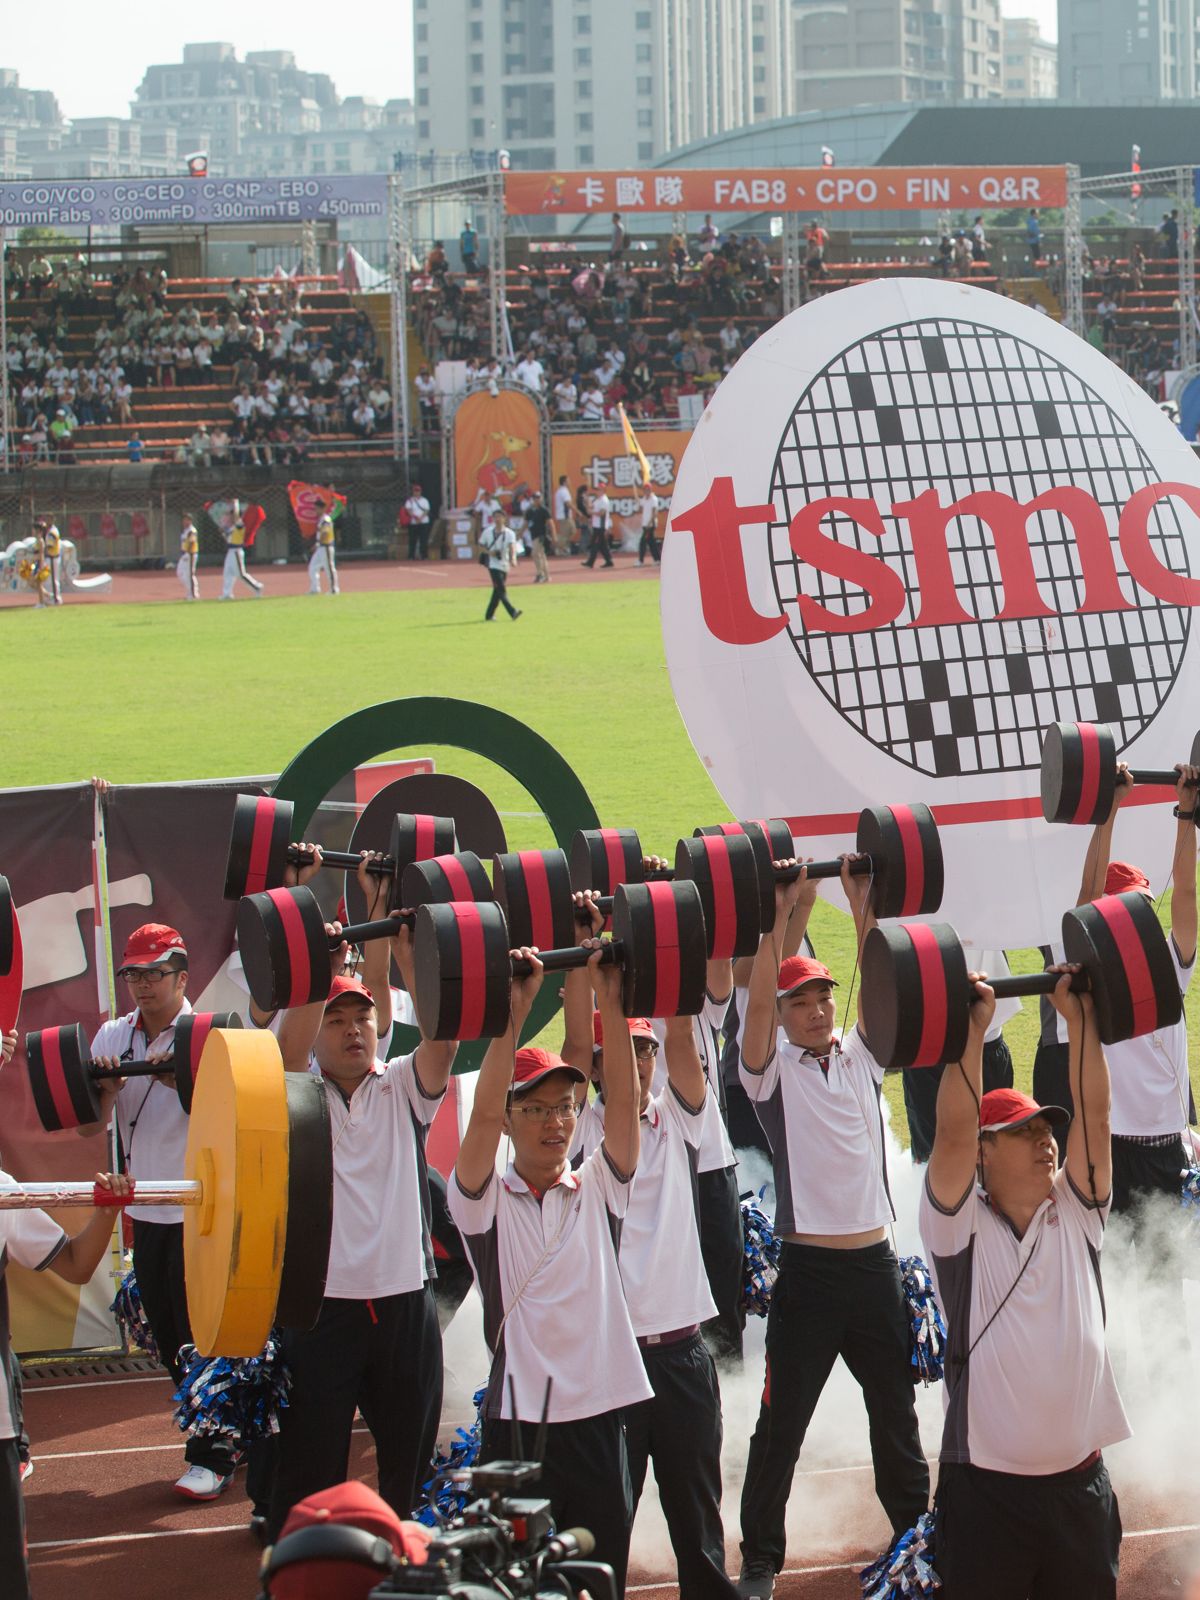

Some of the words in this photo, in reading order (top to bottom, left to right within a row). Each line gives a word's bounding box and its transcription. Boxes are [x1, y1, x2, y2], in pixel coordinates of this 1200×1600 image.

[577, 177, 683, 207] 卡歐隊
[979, 176, 1041, 202] Q&R
[318, 199, 381, 215] 450mm
